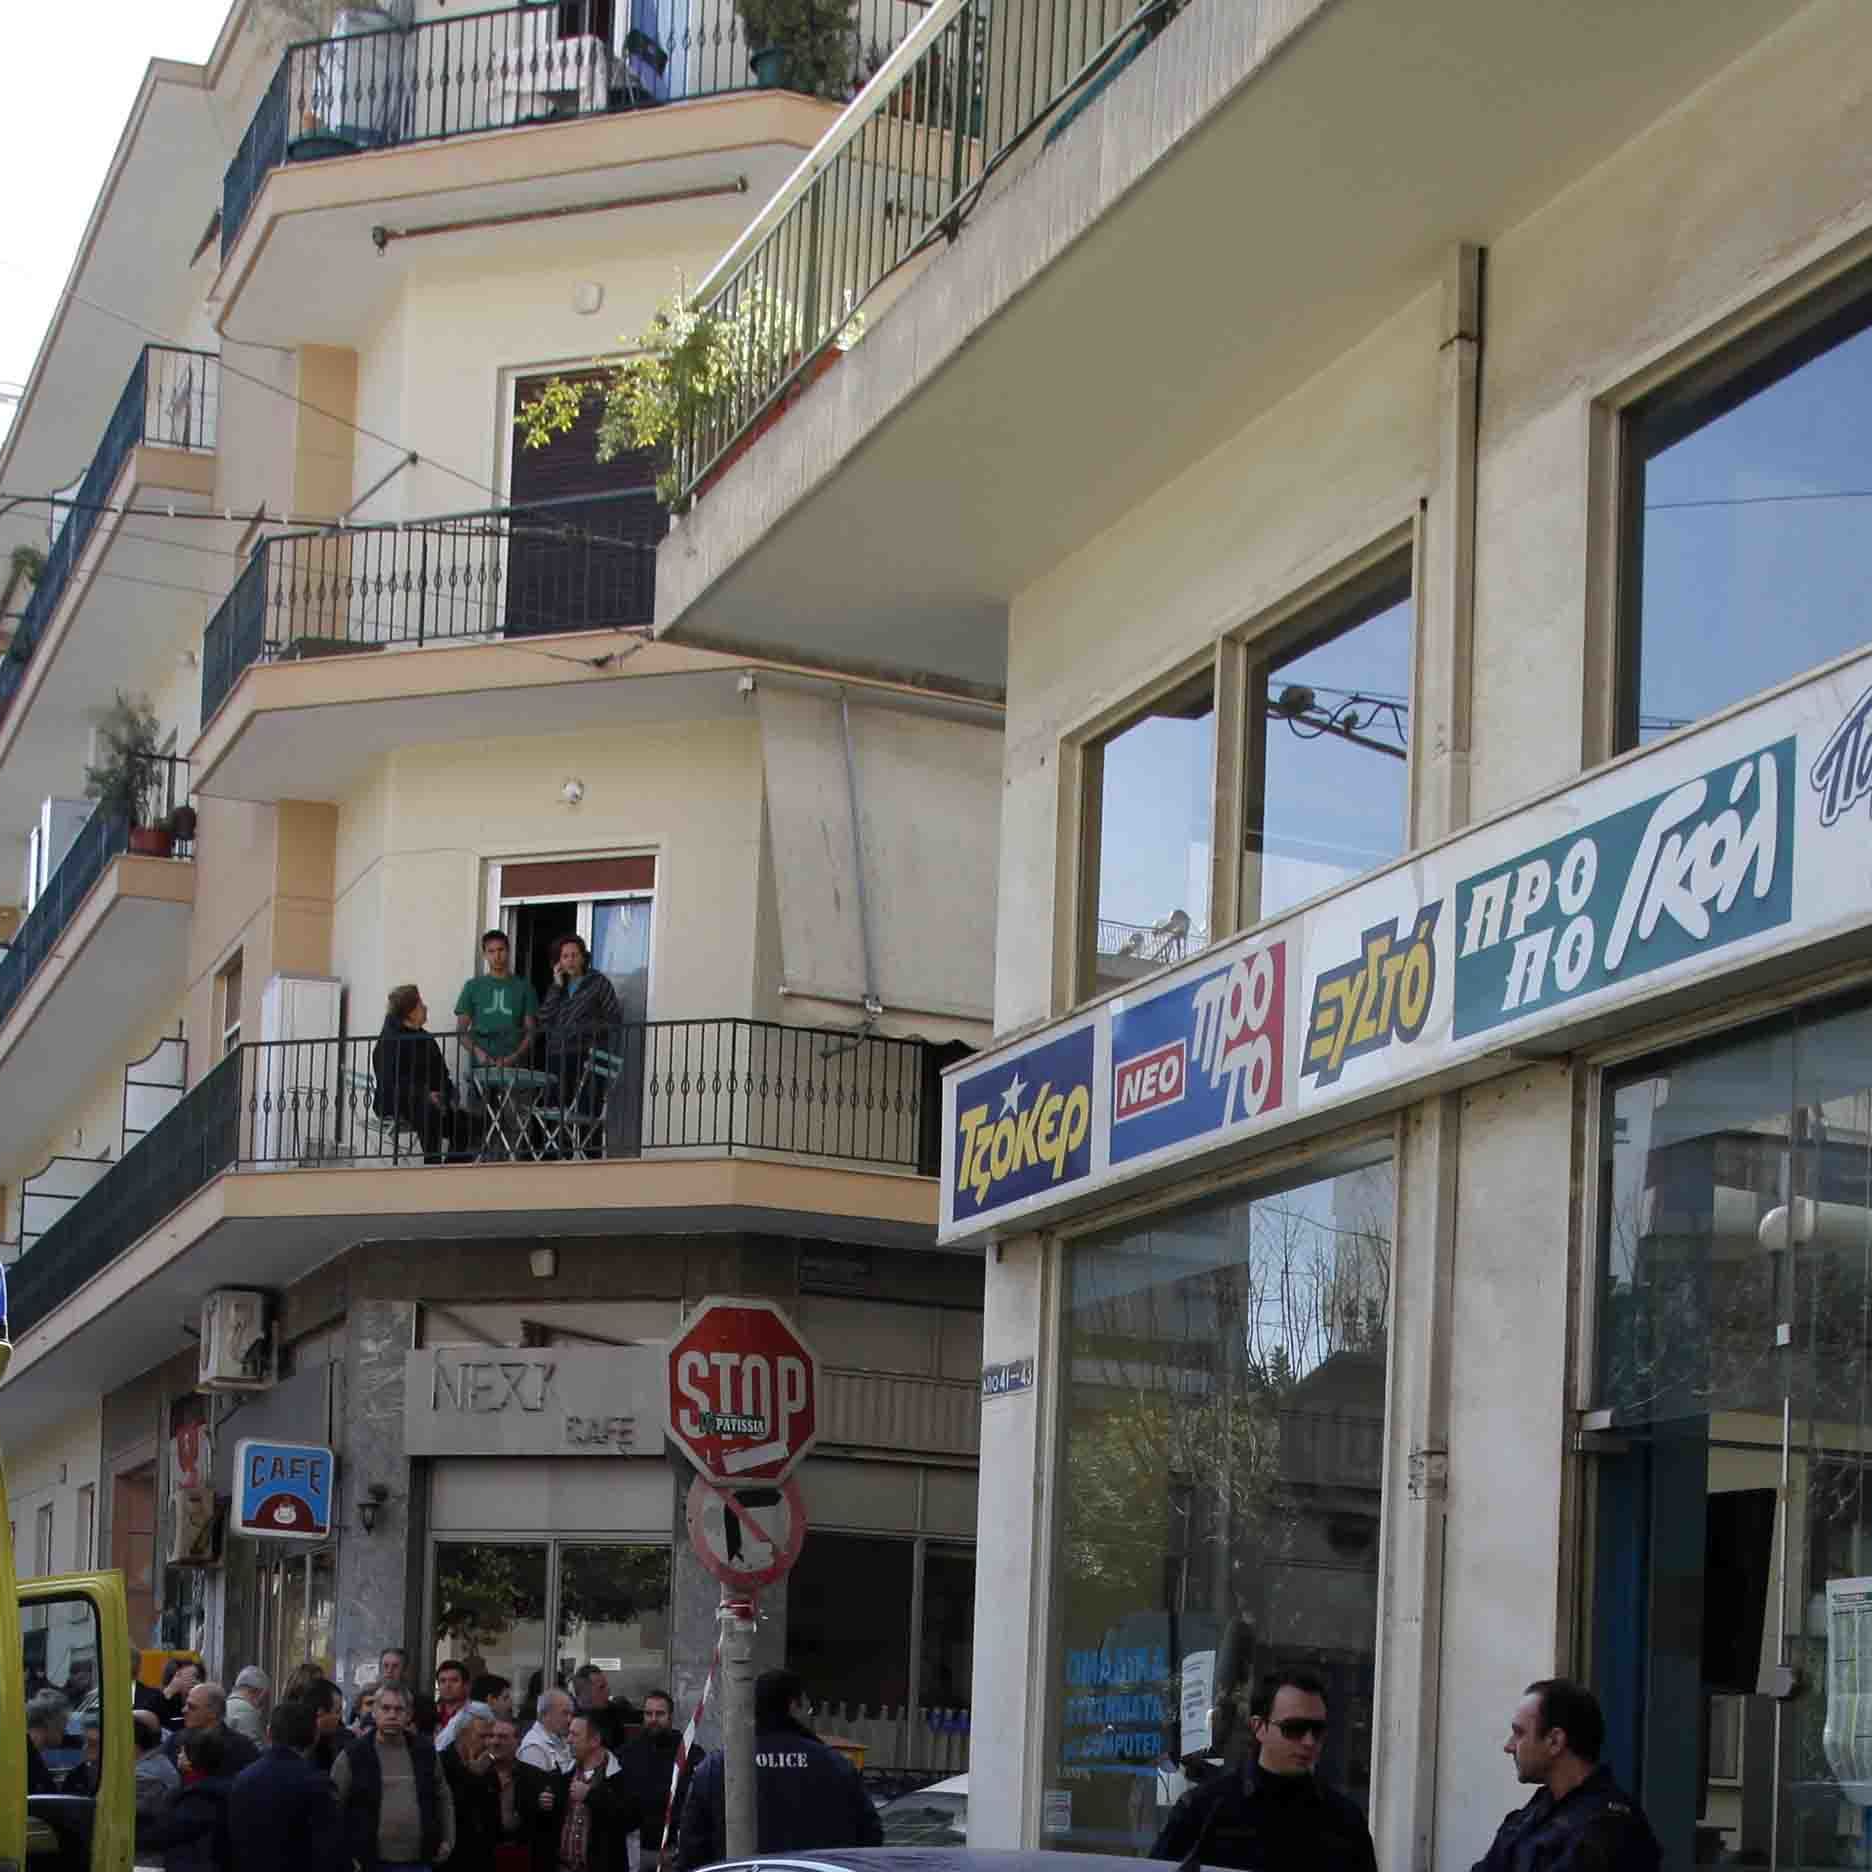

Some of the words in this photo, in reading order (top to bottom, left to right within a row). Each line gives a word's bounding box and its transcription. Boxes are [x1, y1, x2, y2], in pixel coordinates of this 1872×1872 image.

[1460, 837, 1599, 959] ΠΡΟ
[1501, 915, 1594, 1012] ΠΟ
[678, 1351, 807, 1442] STOP
[716, 1417, 766, 1433] PATISSIA
[251, 1455, 324, 1495] CAFE
[755, 1752, 809, 1768] OLICE
